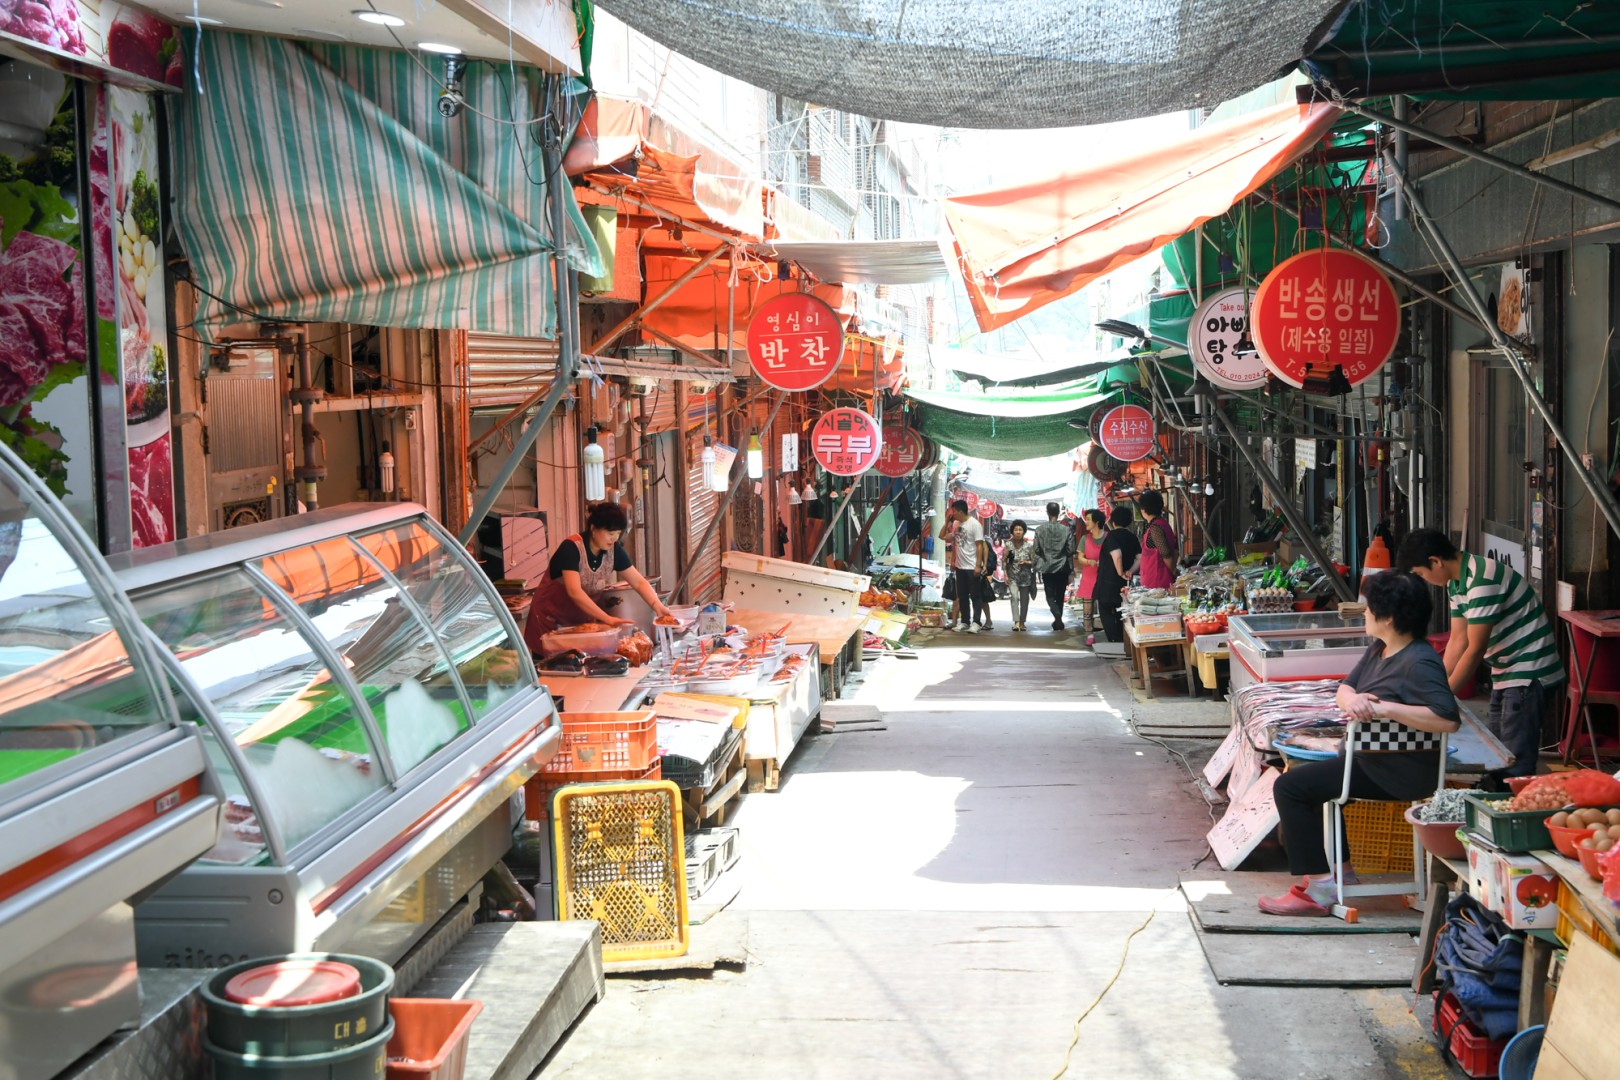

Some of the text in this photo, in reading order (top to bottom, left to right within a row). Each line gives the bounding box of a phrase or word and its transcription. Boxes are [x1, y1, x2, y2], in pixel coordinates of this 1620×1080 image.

[1220, 303, 1235, 312] Take
[1236, 304, 1246, 312] ou
[1279, 278, 1381, 322] 반송생선
[767, 311, 819, 332] 영심이
[759, 336, 830, 369] 반찬
[1338, 328, 1374, 354] 일절)
[821, 412, 869, 432] 시골맛
[1109, 420, 1149, 436] 수진수산
[816, 434, 873, 465] 두부
